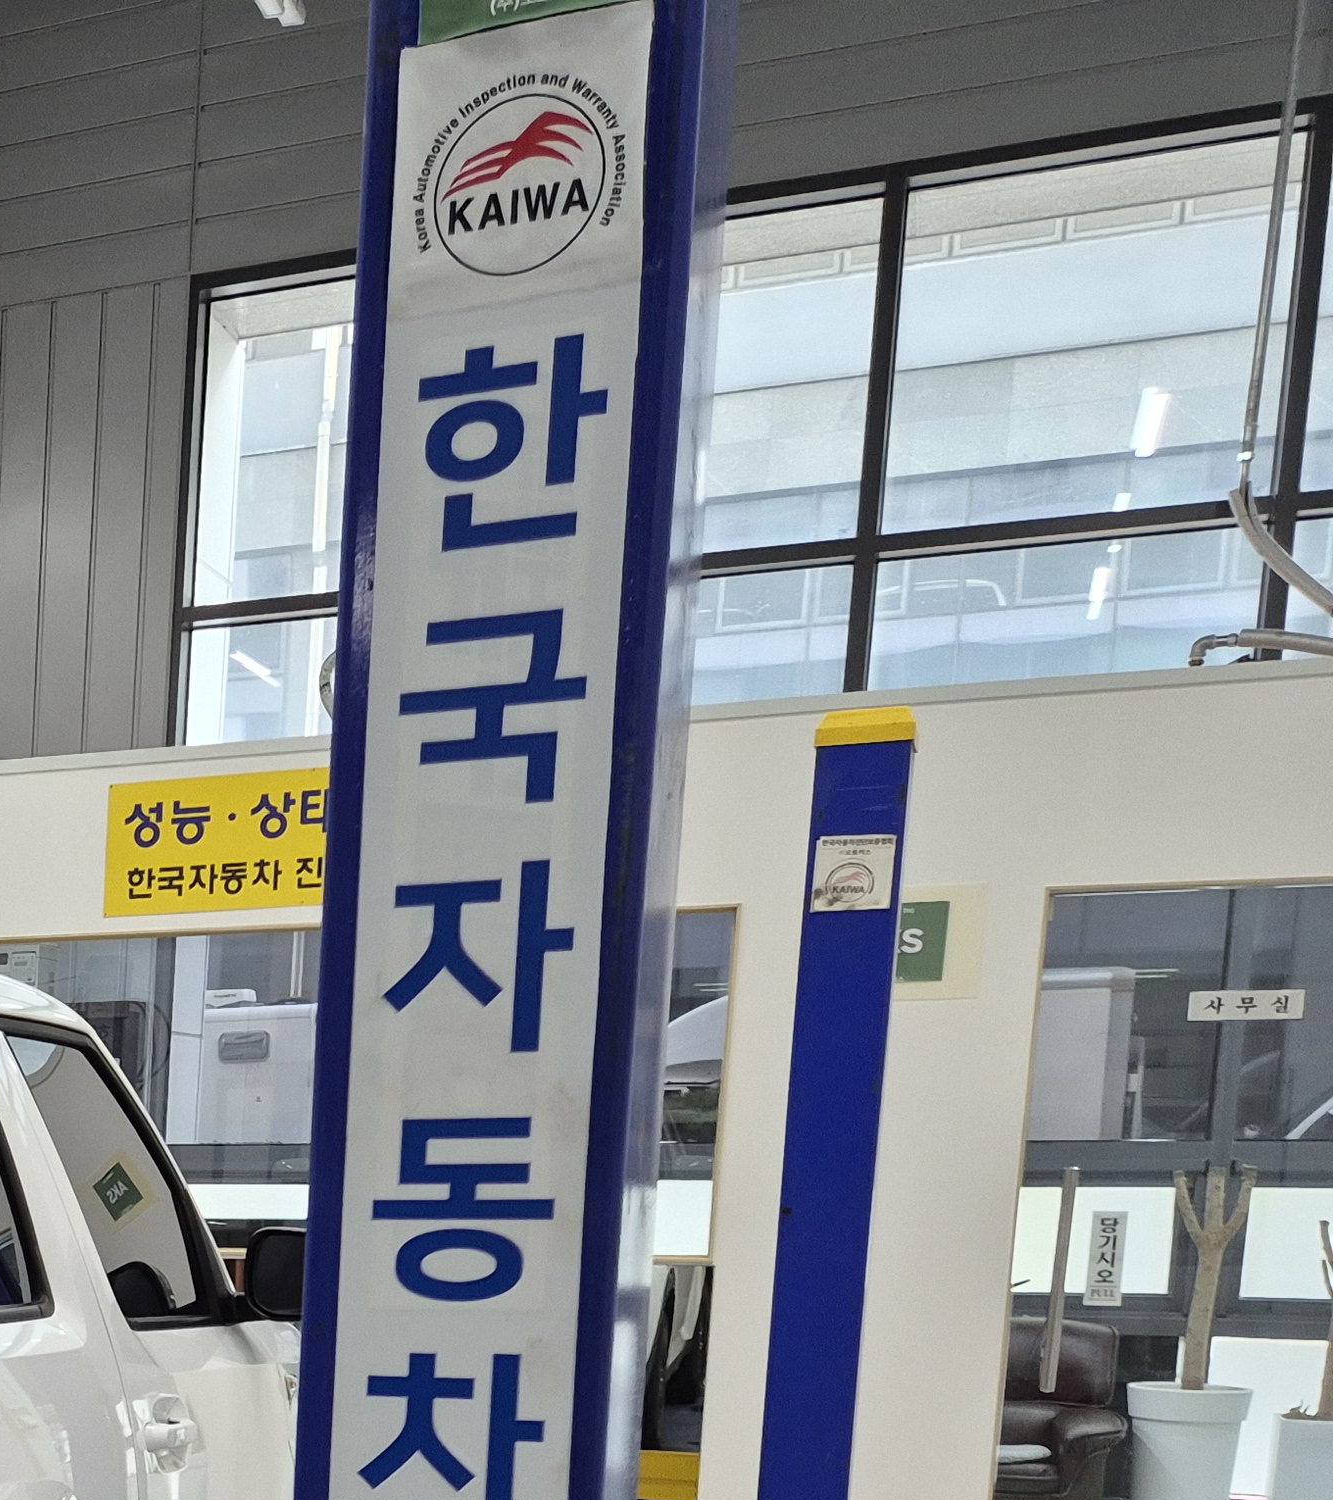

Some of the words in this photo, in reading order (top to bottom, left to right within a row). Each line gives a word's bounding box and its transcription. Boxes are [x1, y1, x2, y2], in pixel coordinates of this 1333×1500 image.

[458, 73, 535, 119] Inspection
[540, 73, 570, 89] and
[571, 77, 620, 130] Warranty
[413, 117, 459, 203] Automotive
[599, 133, 627, 227] Association
[447, 178, 590, 235] KAIWA
[414, 208, 432, 253] Korea
[125, 800, 211, 848] 성능
[127, 858, 282, 900] 한국자동차
[832, 885, 865, 894] KAIWA
[897, 928, 924, 954] S
[1094, 1217, 1120, 1283] 당기시오
